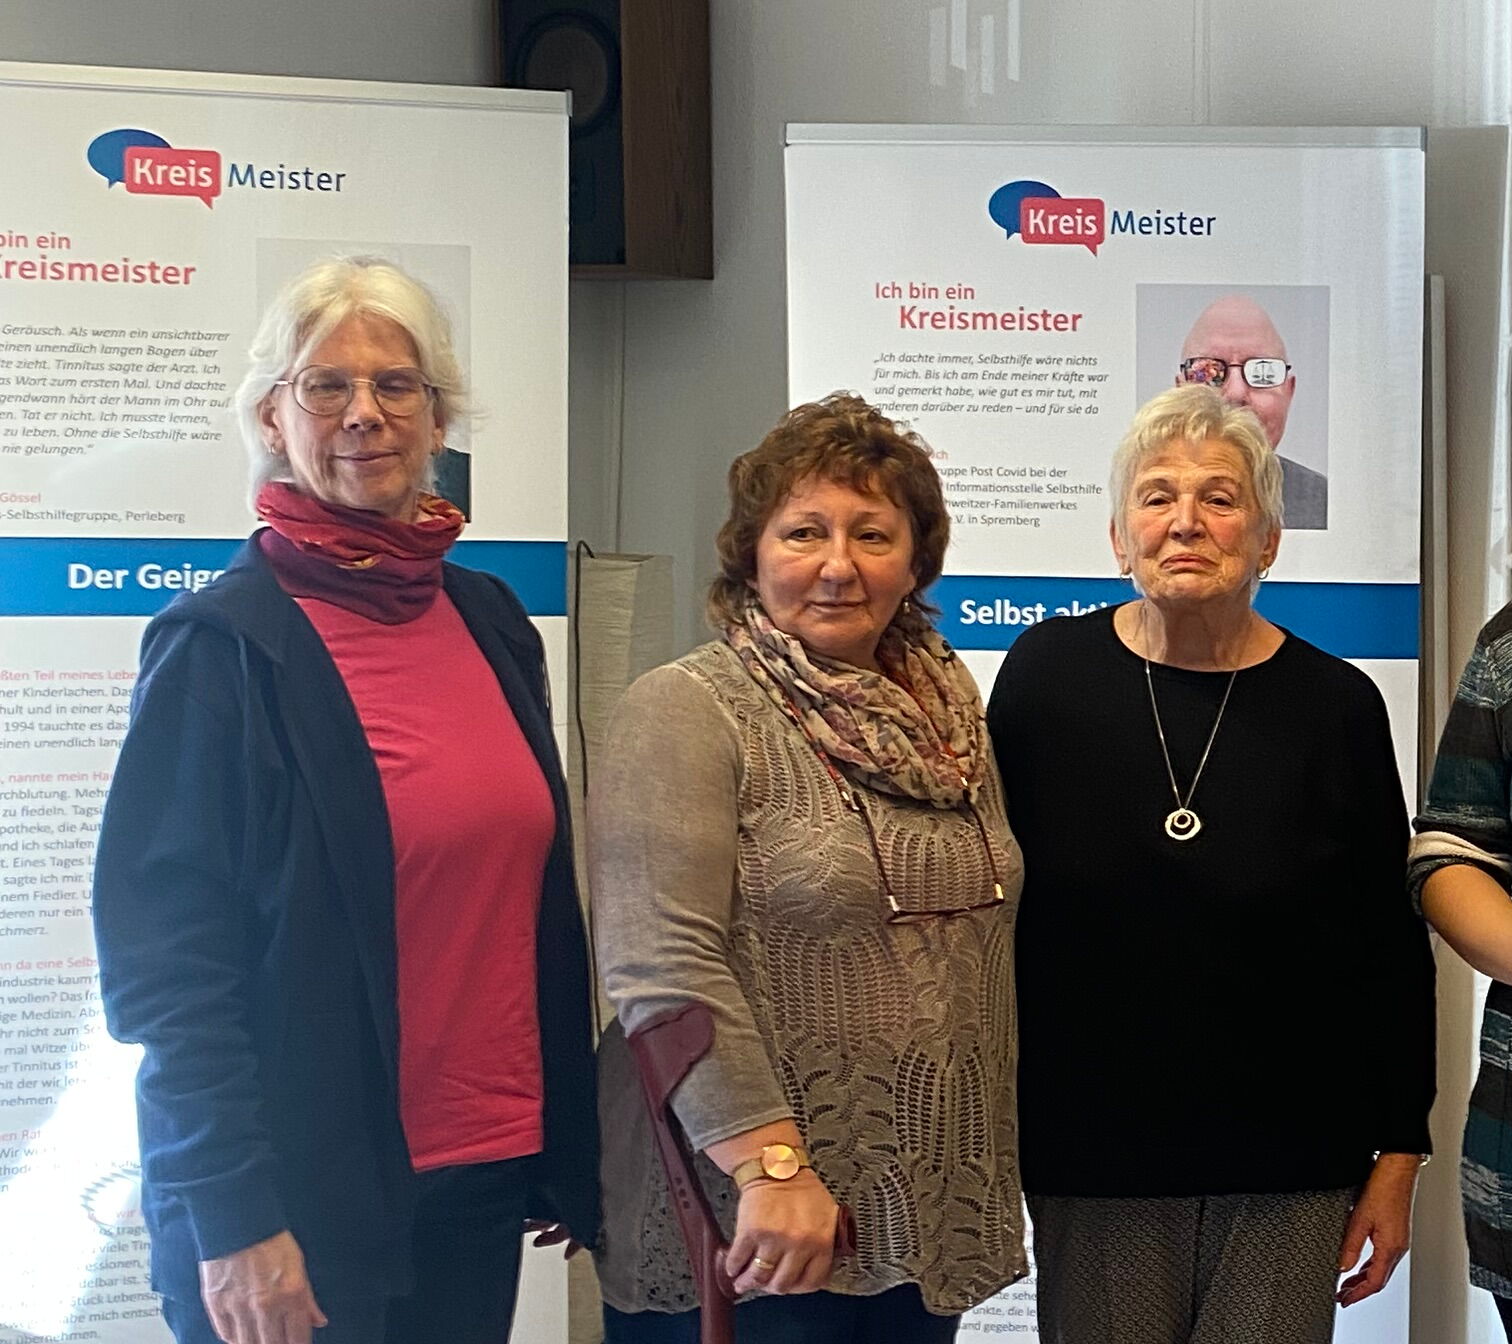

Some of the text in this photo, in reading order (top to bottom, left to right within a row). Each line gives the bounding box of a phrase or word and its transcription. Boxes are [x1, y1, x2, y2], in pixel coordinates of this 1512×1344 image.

[134, 159, 346, 192] Kreis Meister
[1029, 209, 1216, 236] Kreis Meister
[37, 233, 71, 249] ein
[876, 282, 975, 300] Ich bin ein
[900, 306, 1082, 331] Kreismeister
[971, 468, 1067, 477] Post Covid bei der
[946, 483, 1102, 494] Informationsstelle Selbsthilfe
[968, 515, 1040, 526] in Spremberg
[68, 563, 129, 589] Der
[960, 599, 1046, 625] Selbst
